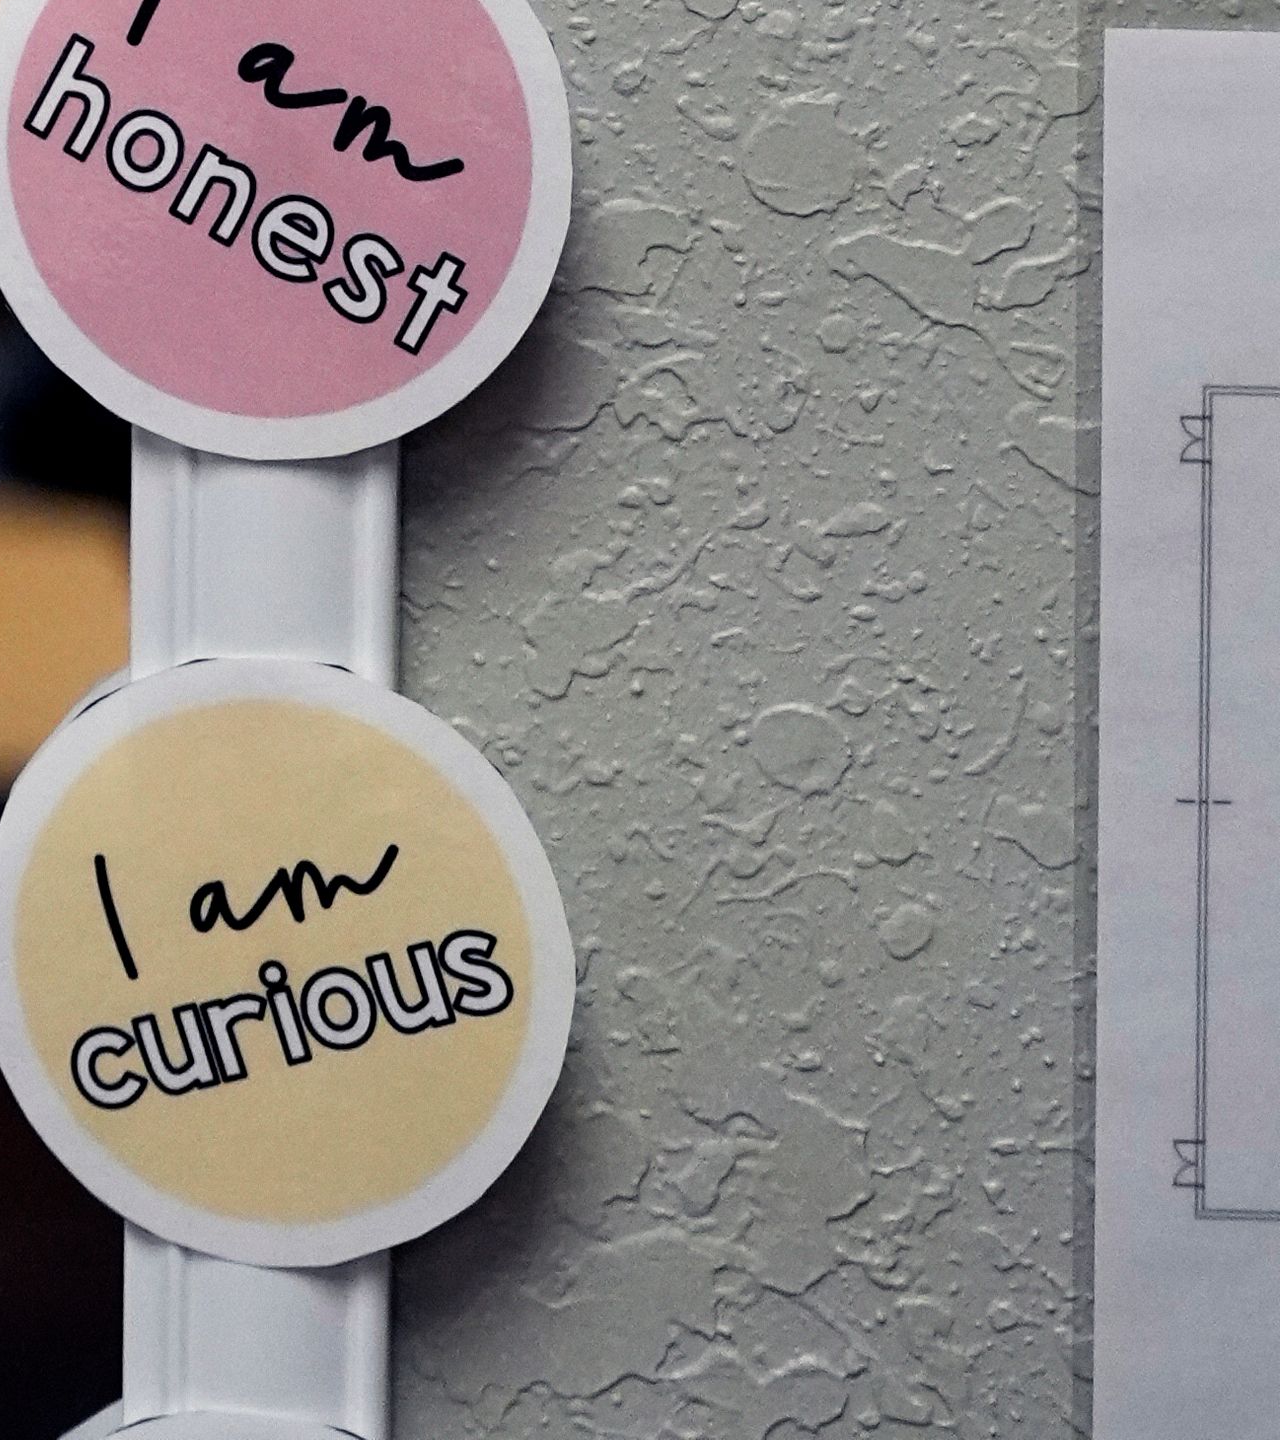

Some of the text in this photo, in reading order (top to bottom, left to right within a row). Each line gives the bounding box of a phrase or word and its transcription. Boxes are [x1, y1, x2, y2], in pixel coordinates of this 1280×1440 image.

[238, 43, 464, 181] am
[23, 33, 468, 356] honest
[94, 844, 399, 980] I am
[71, 930, 514, 1110] curious
